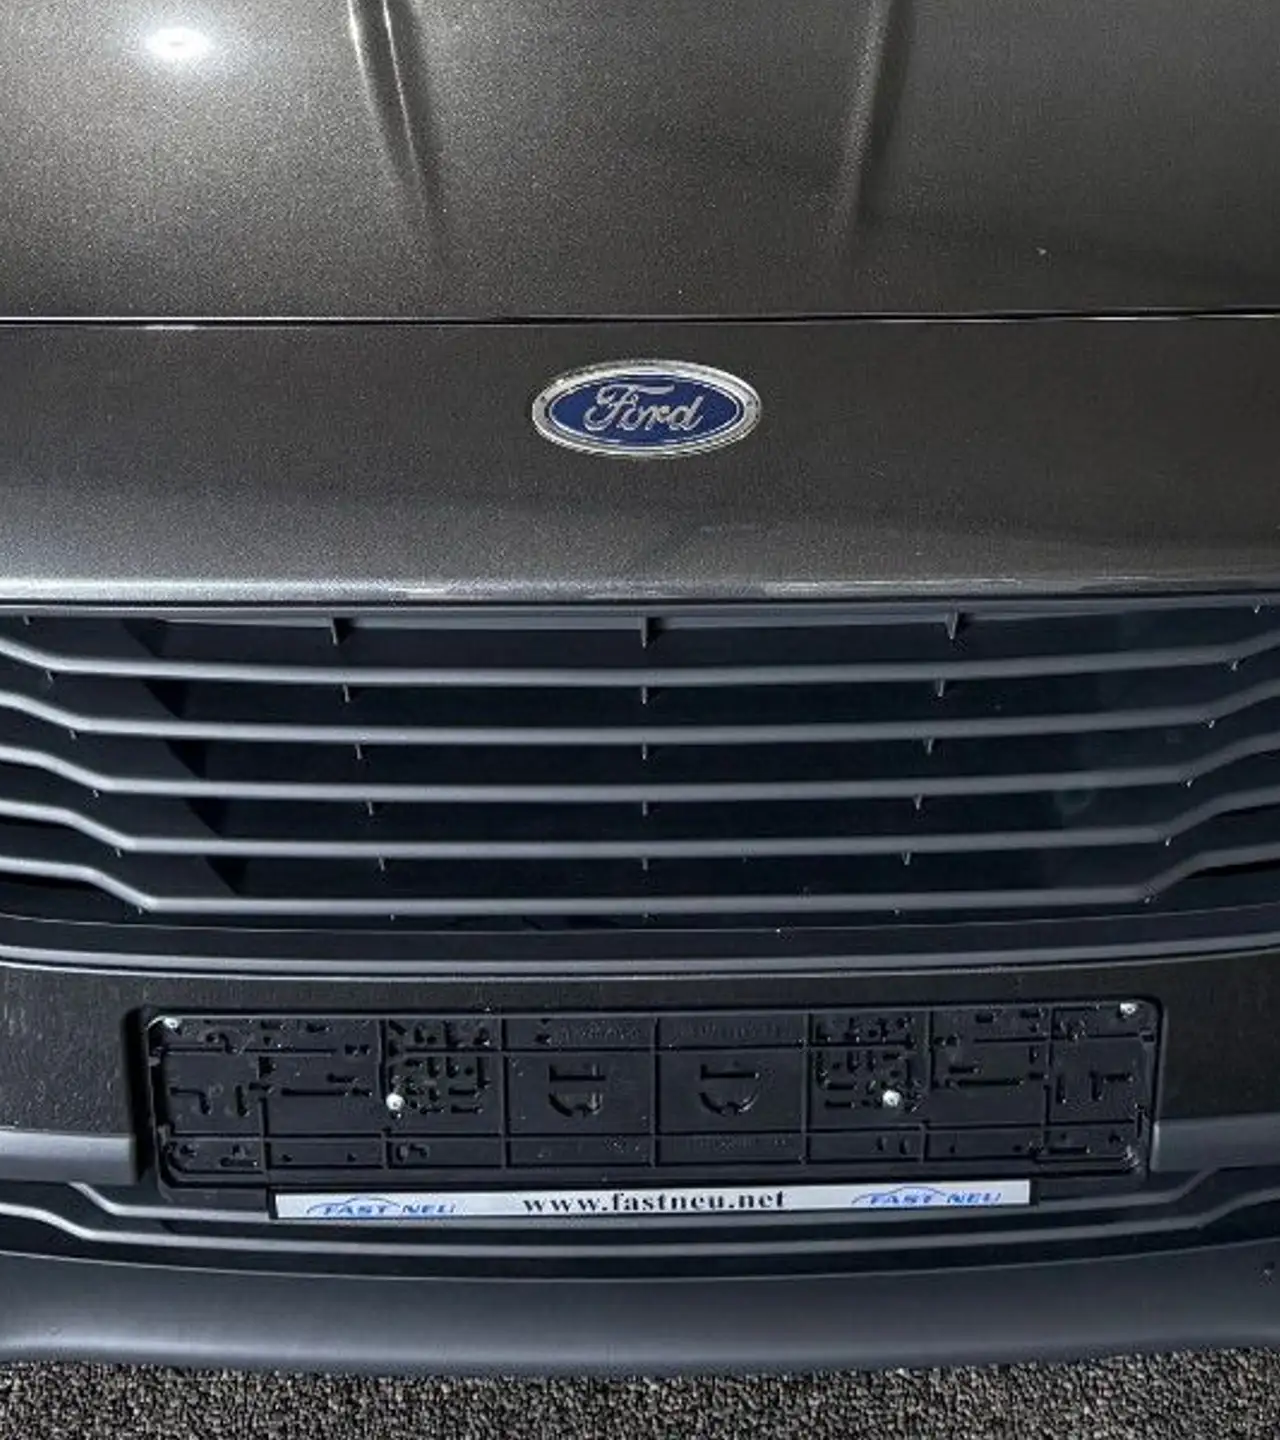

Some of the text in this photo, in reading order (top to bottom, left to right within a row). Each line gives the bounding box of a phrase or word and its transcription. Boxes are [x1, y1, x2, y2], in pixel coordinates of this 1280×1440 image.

[583, 383, 704, 432] Ford
[523, 1191, 786, 1213] www.fastneu.net
[869, 1192, 1002, 1205] FAST NEU
[323, 1202, 456, 1216] FAST NEU
